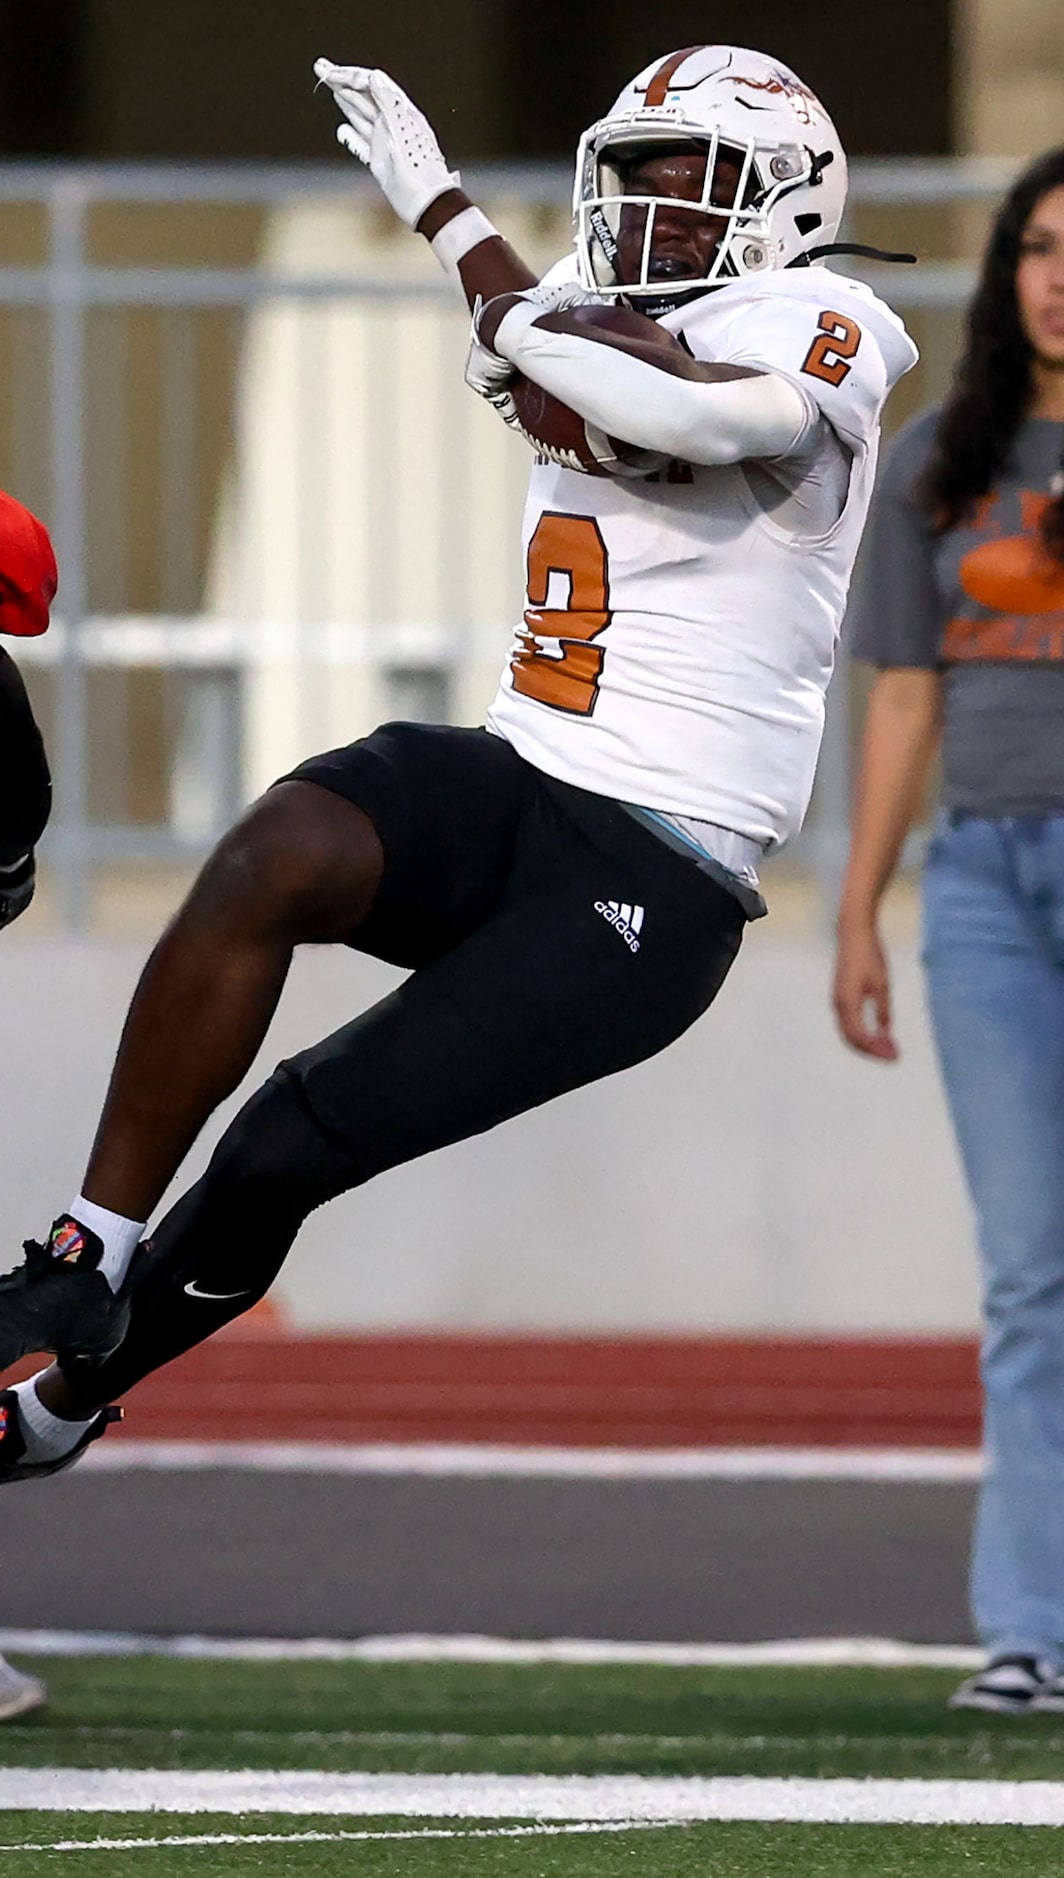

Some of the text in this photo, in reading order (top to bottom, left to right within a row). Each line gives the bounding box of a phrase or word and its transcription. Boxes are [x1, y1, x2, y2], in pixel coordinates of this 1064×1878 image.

[799, 310, 862, 388] 2
[509, 510, 614, 717] 2
[593, 900, 641, 954] adidas
